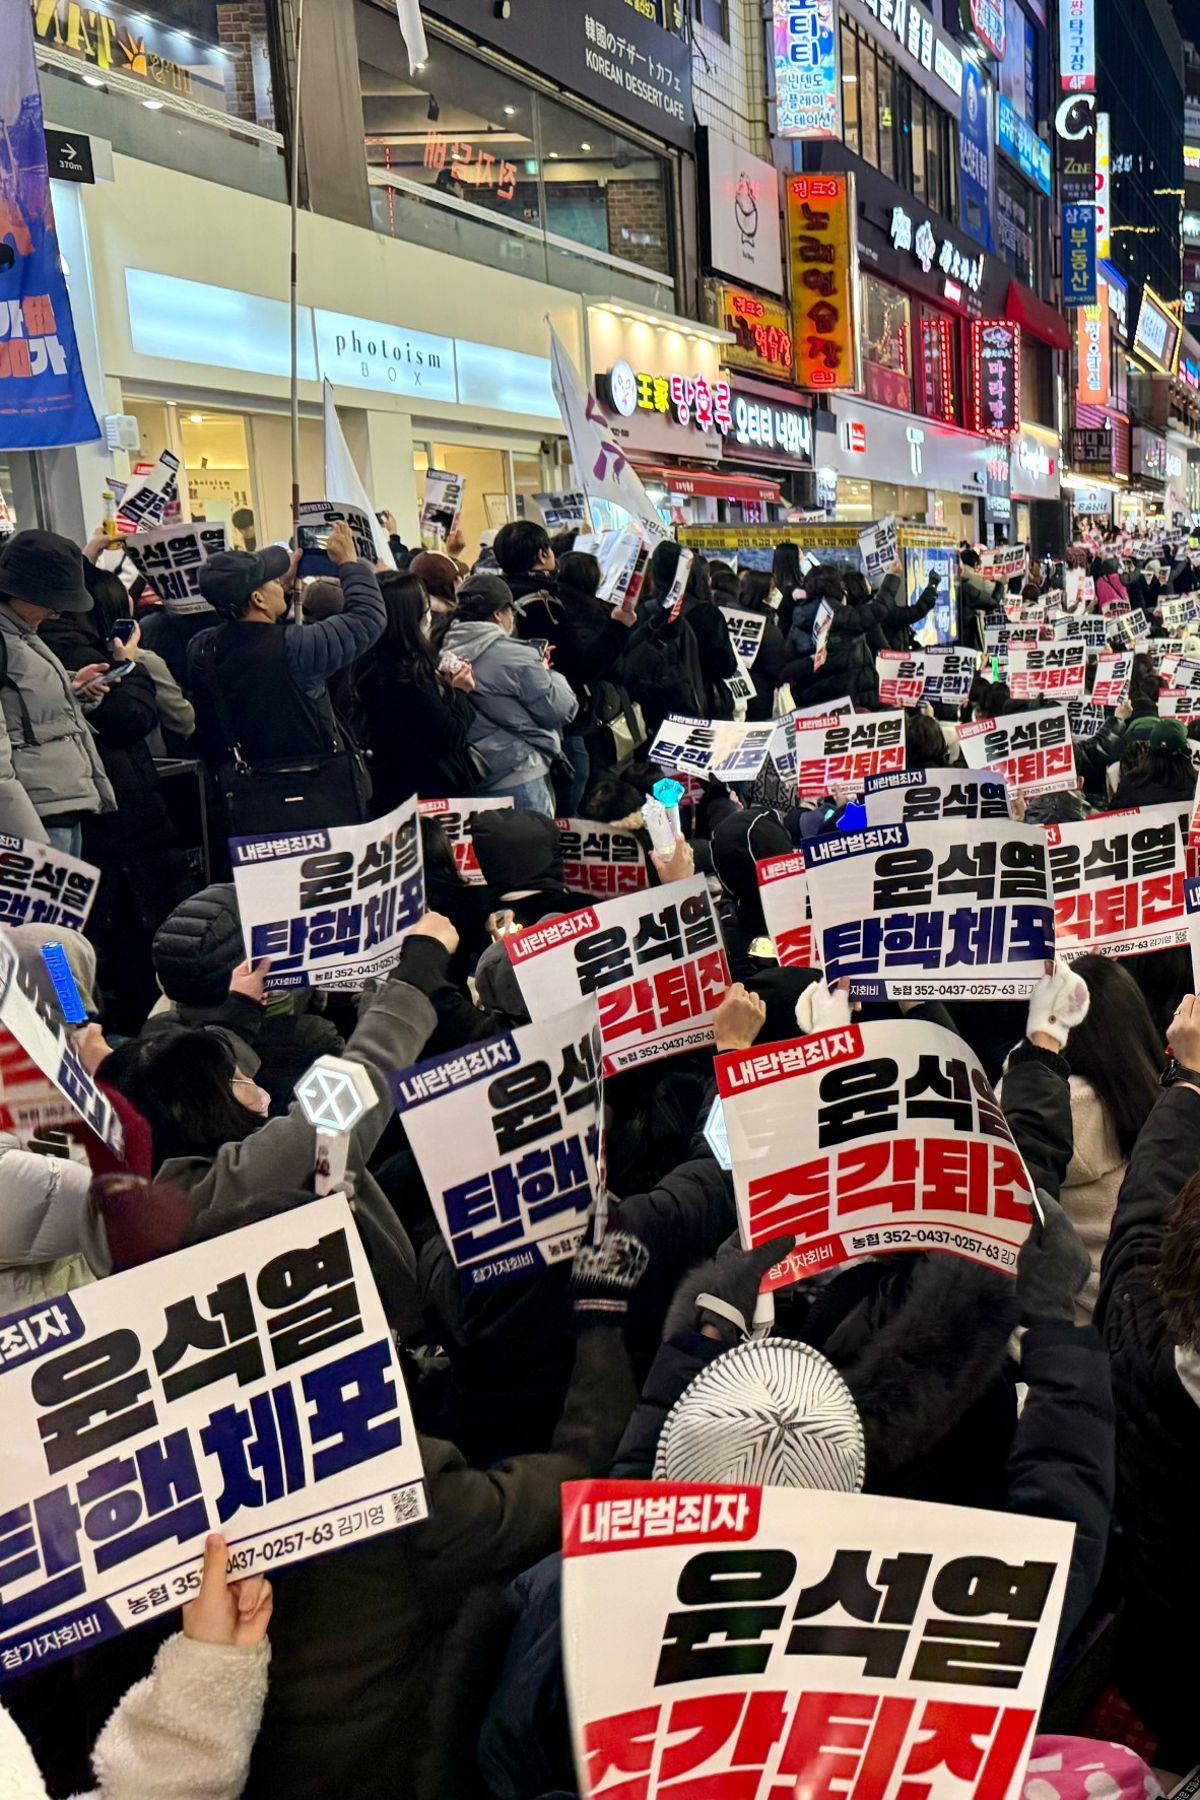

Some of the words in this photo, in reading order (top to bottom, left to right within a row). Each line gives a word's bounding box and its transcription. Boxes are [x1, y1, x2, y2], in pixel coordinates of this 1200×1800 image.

[1069, 19, 1084, 71] 탁구장
[585, 48, 623, 86] KOREAN
[625, 72, 662, 108] DESSERT
[664, 94, 684, 121] CAFE
[786, 72, 824, 88] 닌텐도
[788, 93, 824, 109] 플레이
[1069, 76, 1086, 90] 4F
[782, 111, 832, 128] 스테이션
[59, 160, 82, 172] 370m
[1064, 158, 1092, 174] ZONE
[793, 180, 838, 198] 핑크3
[1065, 209, 1092, 224] 삼주
[1070, 227, 1088, 292] 부동산
[335, 329, 442, 370] photoism
[361, 361, 423, 388] BOX
[736, 397, 773, 448] 오티티
[1026, 646, 1084, 669] 윤석열
[1010, 666, 1084, 692] 즉각퇴진
[668, 713, 709, 728] 내란범죄자
[799, 714, 838, 729] 내란범죄자
[823, 718, 903, 755] 윤석열
[957, 719, 995, 739] 내란범죄자
[983, 718, 1067, 763] 윤석열
[798, 746, 904, 788] 즉각퇴진
[868, 772, 923, 792] 내란범죄자
[901, 781, 1010, 823] 윤석열
[237, 833, 327, 862] 내란범죄자
[298, 813, 419, 910] 윤석열
[809, 826, 904, 862] 내란범죄자
[873, 840, 1048, 912] 윤석열
[250, 872, 425, 971] 탄핵체포
[1054, 870, 1186, 941] 각퇴진
[511, 909, 594, 958] 내란범죄자
[573, 888, 719, 997] 윤석열
[823, 903, 1056, 993] 탄핵체포
[598, 948, 732, 1043] 각퇴진
[892, 984, 913, 996] 농협
[914, 984, 1016, 996] 352-0437-0257-63
[399, 1036, 514, 1102] 내란범죄자
[616, 1052, 637, 1067] 농협
[638, 1030, 716, 1059] 352-0437-0257-63
[725, 1032, 857, 1087] 내란범죄자
[766, 1245, 835, 1283] 참가자회비
[851, 1231, 882, 1249] 농협
[882, 1228, 1001, 1260] 352-0437-0257-63
[30, 1226, 365, 1476] 윤석열
[0, 1337, 403, 1630] 탄핵체포
[578, 1492, 750, 1544] 내란범죄자
[127, 1577, 171, 1615] 농협
[335, 1504, 386, 1539] 김기영
[653, 1548, 1058, 1691] 윤석열
[1, 1613, 102, 1670] 참가자회비
